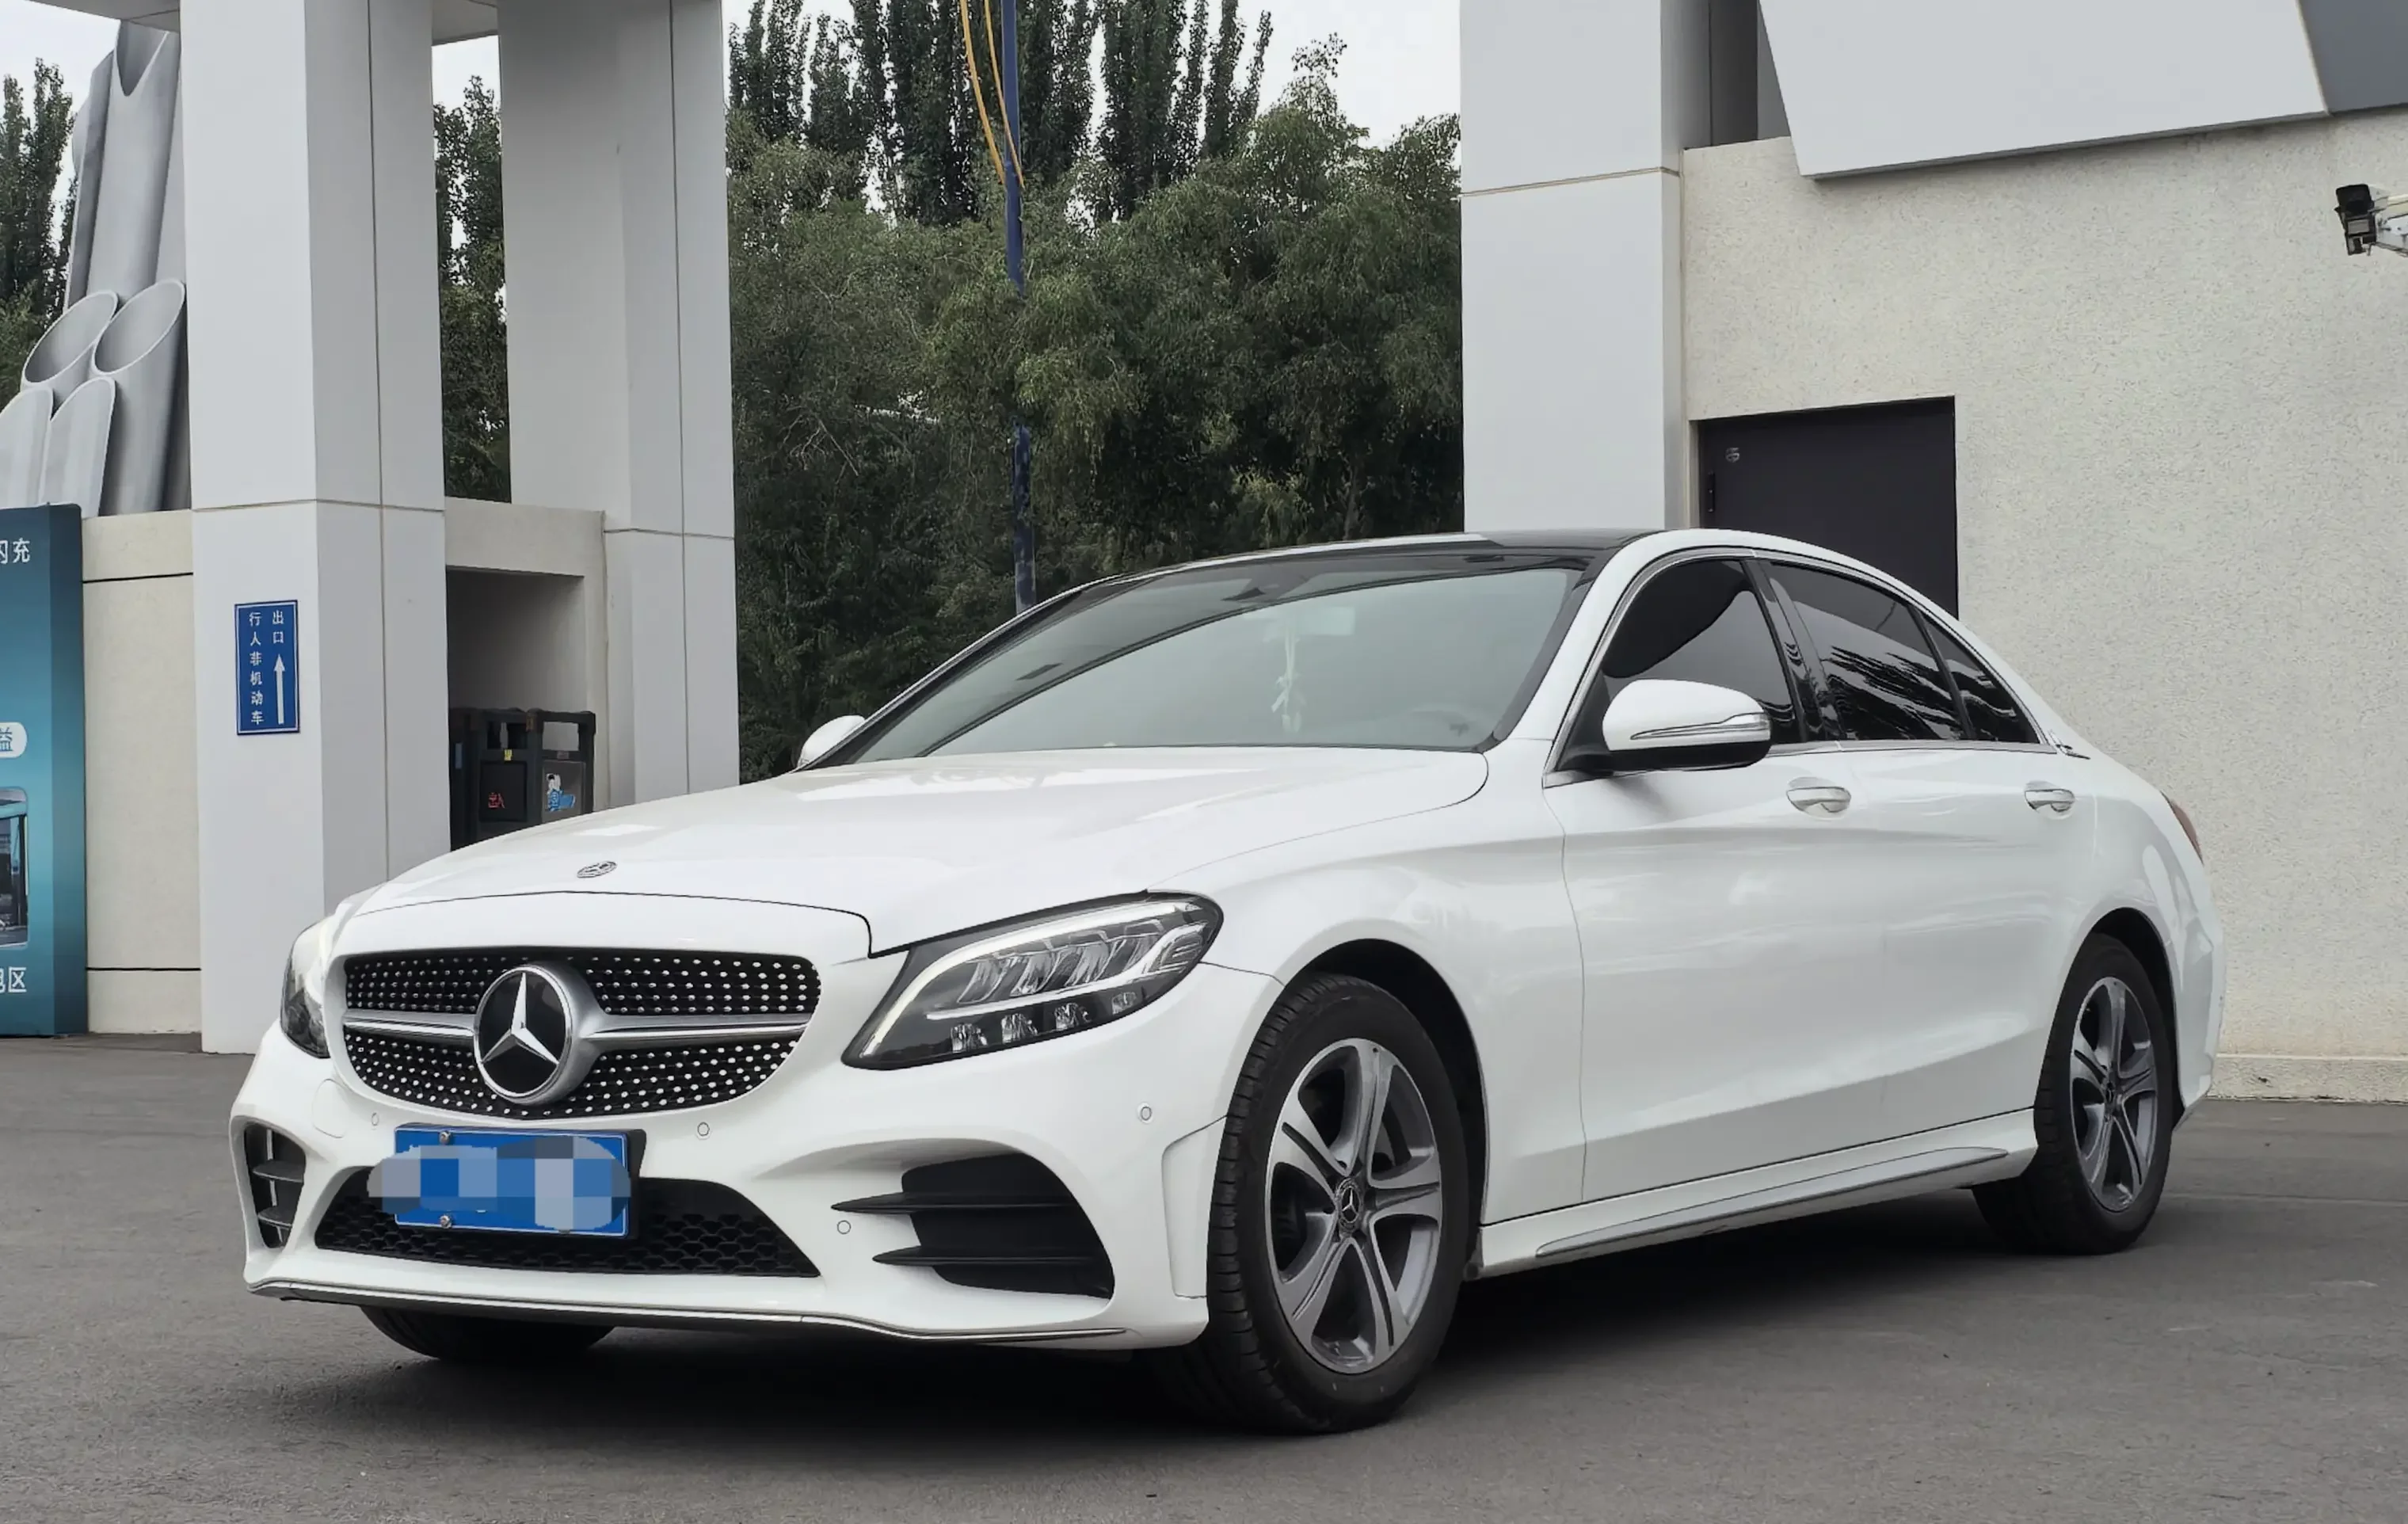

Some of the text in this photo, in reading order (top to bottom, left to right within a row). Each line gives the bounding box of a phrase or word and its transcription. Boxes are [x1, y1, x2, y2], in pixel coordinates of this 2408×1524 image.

[272, 610, 284, 644] 出口
[249, 612, 264, 725] 行人非机动车
